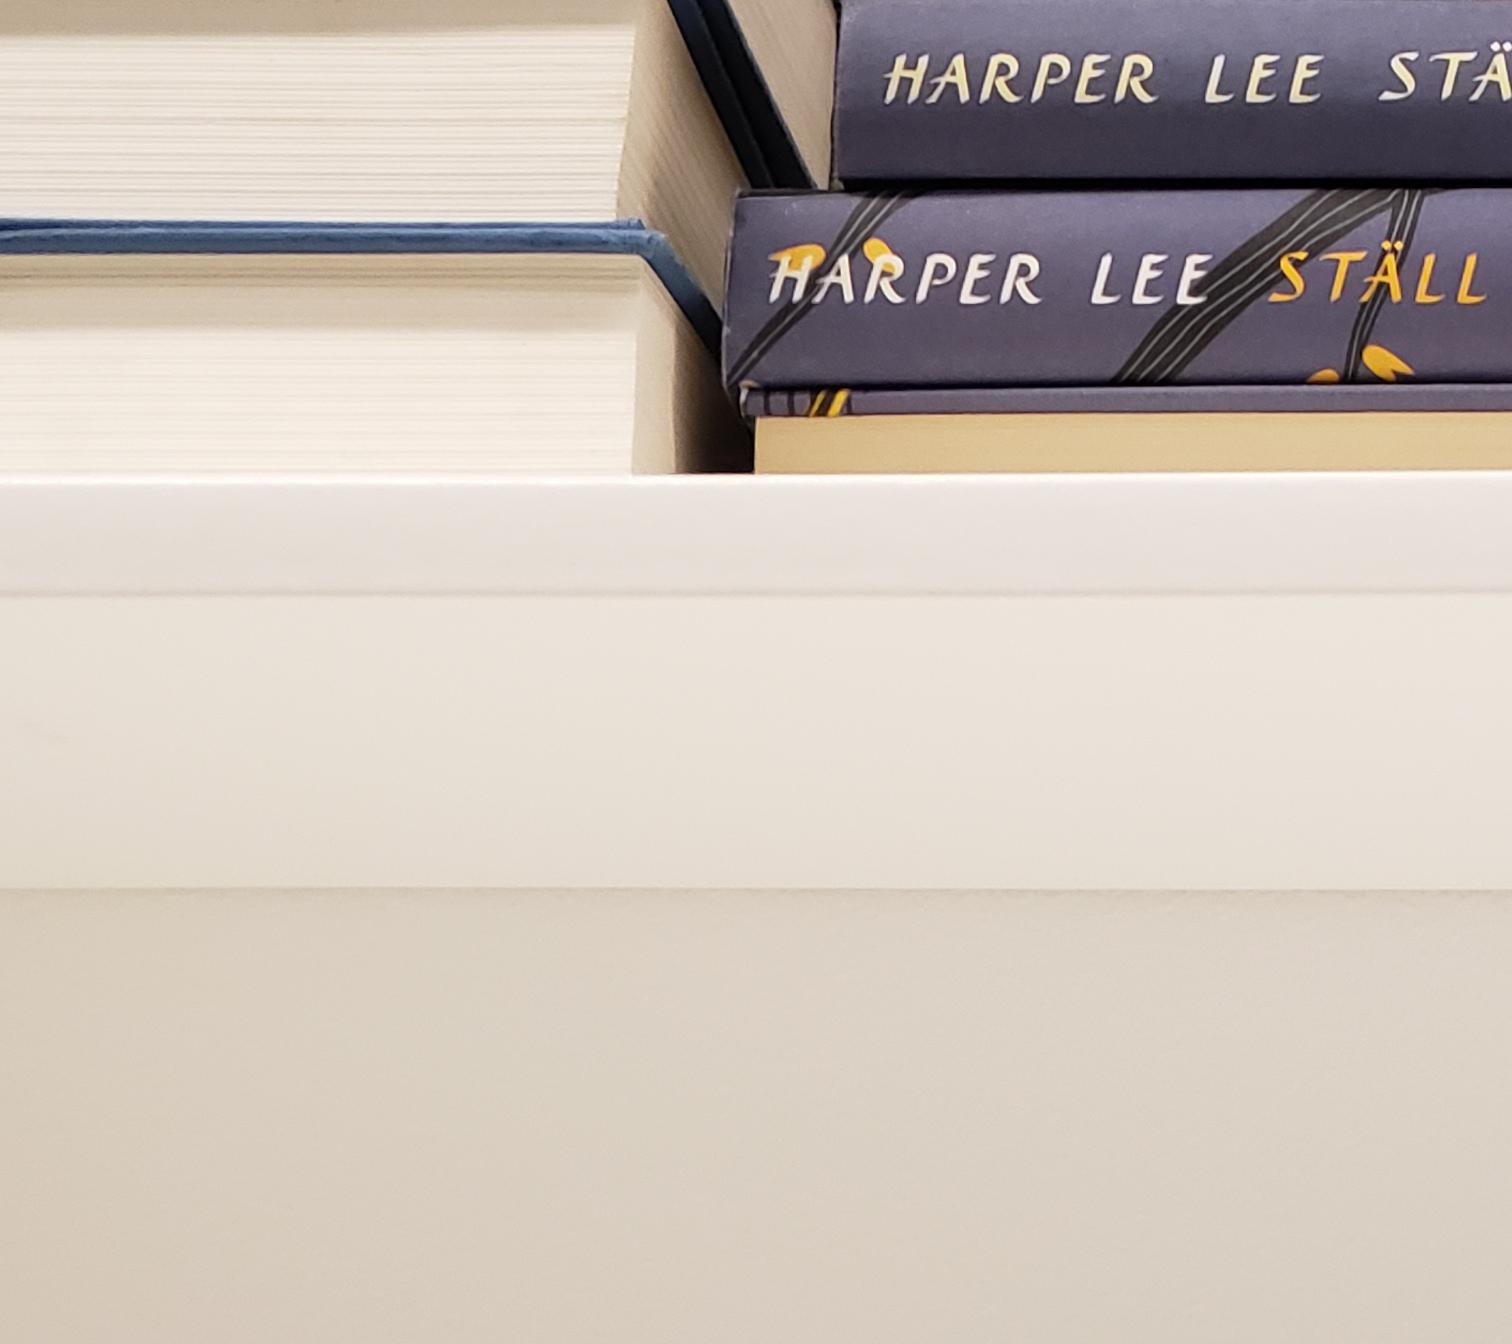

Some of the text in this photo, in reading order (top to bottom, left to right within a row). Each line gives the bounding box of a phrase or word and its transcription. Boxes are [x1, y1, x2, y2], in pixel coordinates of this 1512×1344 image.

[882, 52, 1160, 105] HARPER
[1204, 53, 1325, 104] LEE
[768, 252, 1043, 306] HARPER
[1091, 252, 1209, 305] LEE
[1268, 240, 1487, 305] STÄLL
